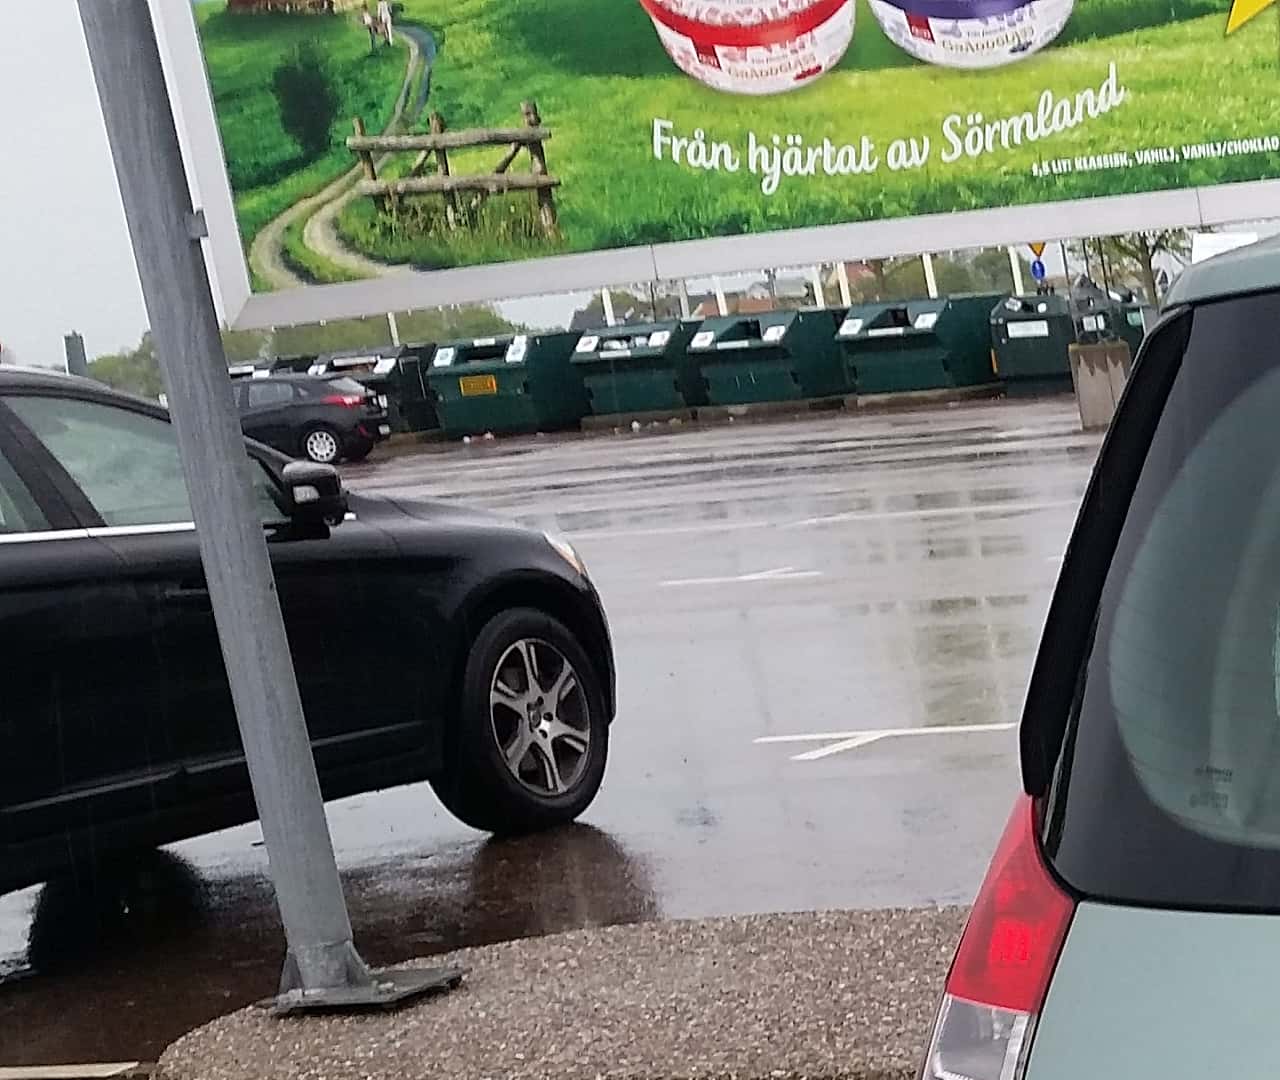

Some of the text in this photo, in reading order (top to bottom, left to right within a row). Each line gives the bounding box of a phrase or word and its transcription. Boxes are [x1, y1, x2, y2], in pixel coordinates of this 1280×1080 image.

[652, 61, 1126, 196] Från hjärtat av Sörmland
